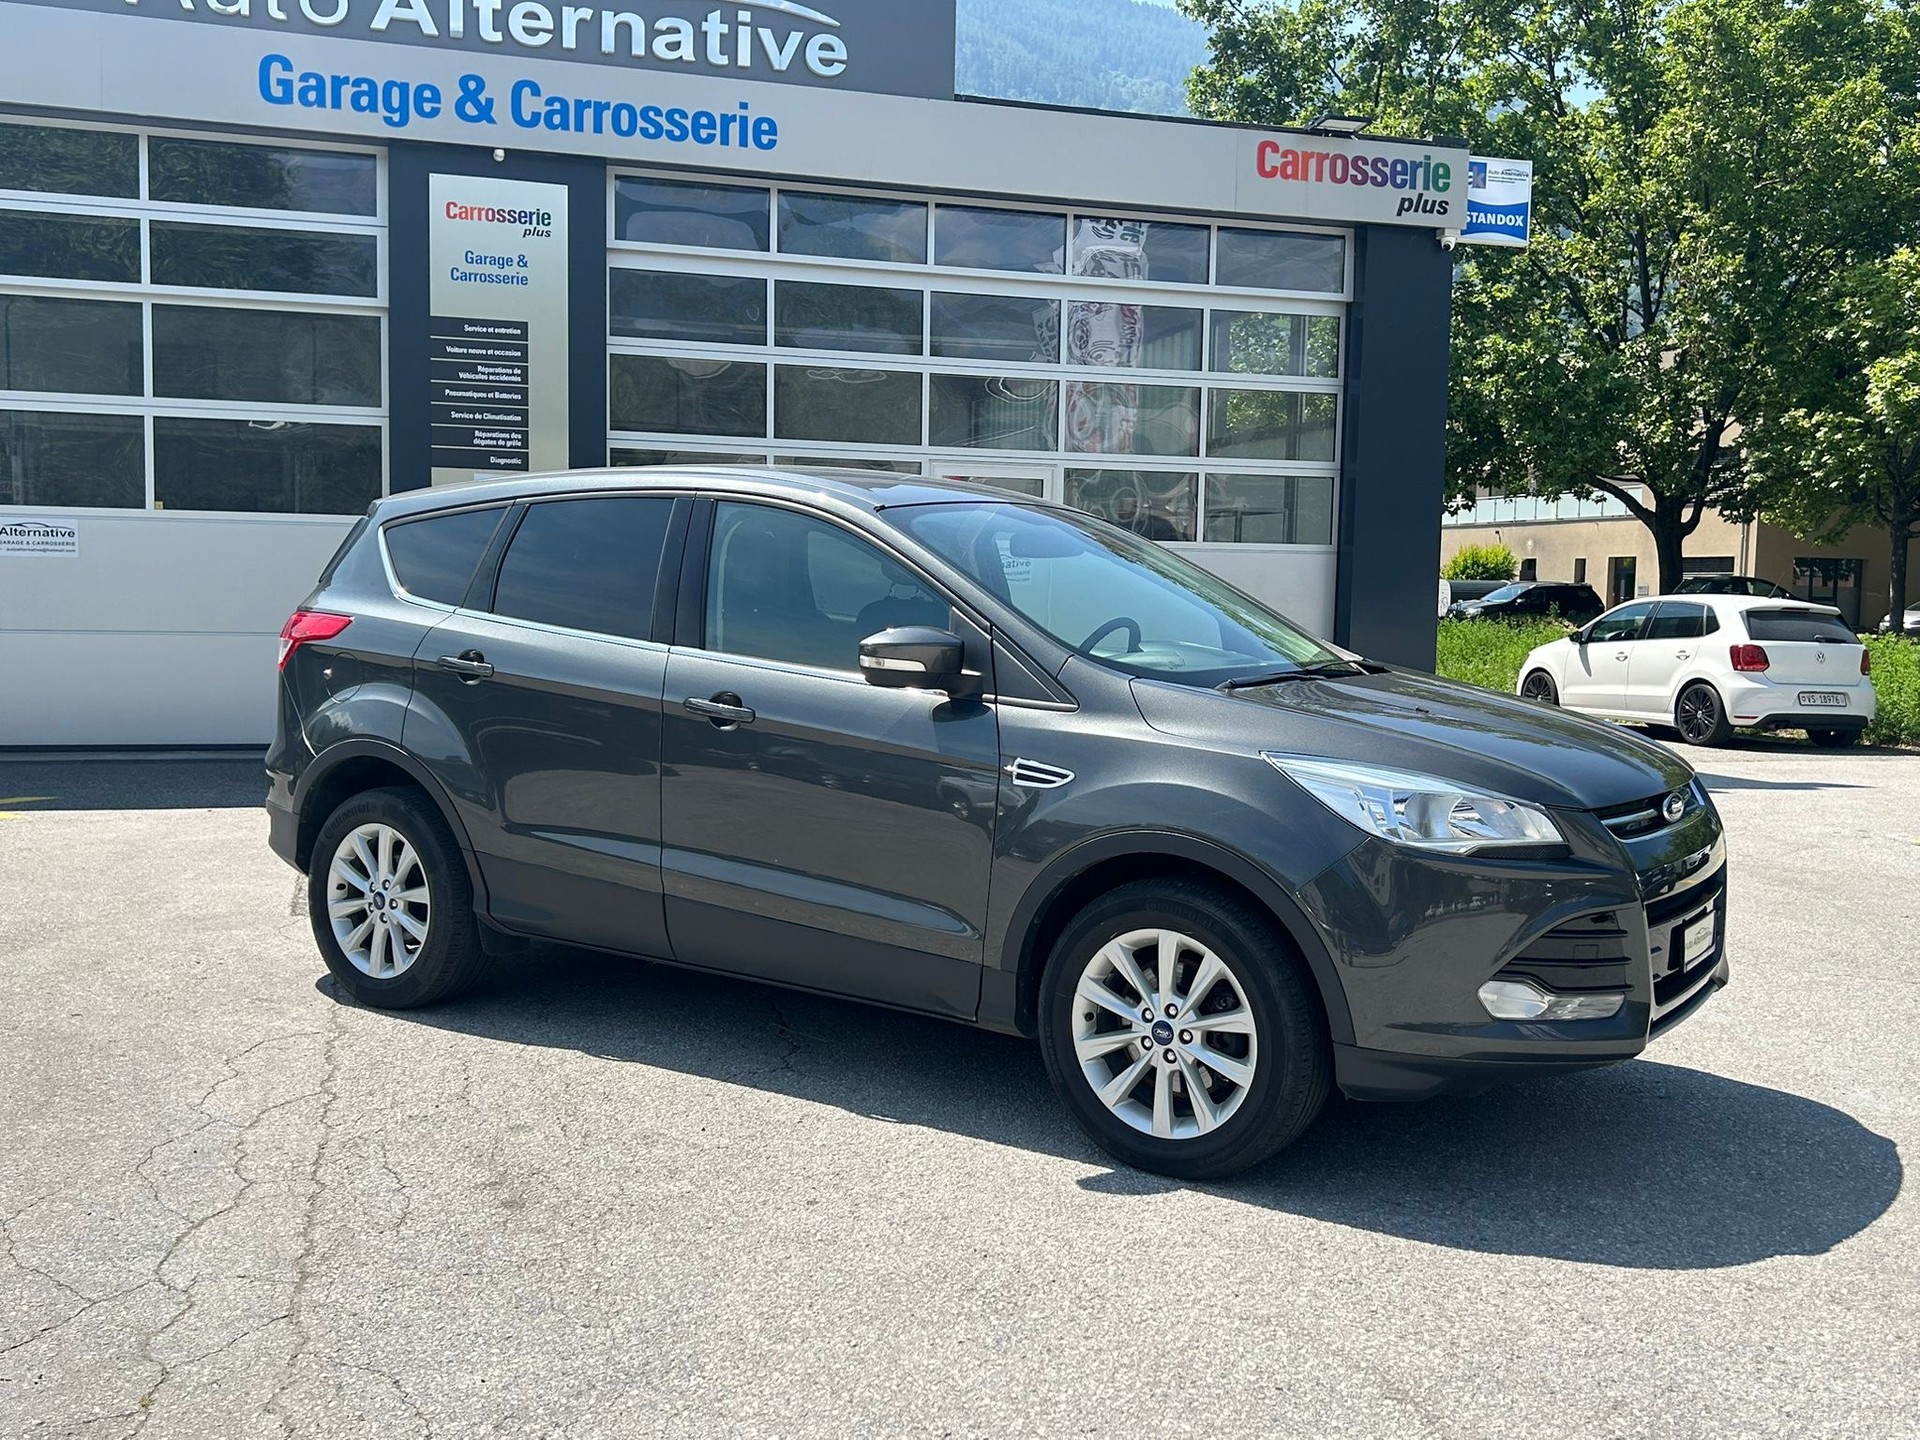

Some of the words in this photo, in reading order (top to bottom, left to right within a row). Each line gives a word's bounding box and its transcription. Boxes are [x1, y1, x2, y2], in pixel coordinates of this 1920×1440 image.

[370, 0, 848, 77] Alternative
[258, 54, 442, 127] Garage
[455, 73, 497, 125] &
[510, 79, 779, 151] Carrosserie
[1256, 140, 1451, 193] Carrosserie
[1397, 193, 1450, 216] plus
[445, 201, 552, 226] Carrosserie
[523, 227, 552, 238] plus
[465, 250, 514, 269] Garage
[517, 254, 529, 268] &
[450, 267, 529, 286] Carrosserie
[464, 324, 487, 333] Service
[495, 327, 521, 335] entretien
[446, 345, 467, 353] Voiture
[444, 389, 487, 399] Pneumatiques
[495, 392, 521, 400] Batteries
[451, 411, 473, 419] Service
[483, 413, 521, 421] Climatisation
[490, 456, 521, 464] Diagnostic
[0, 527, 75, 538] Alternative
[1807, 695, 1816, 703] VS
[1819, 695, 1840, 704] 18976
